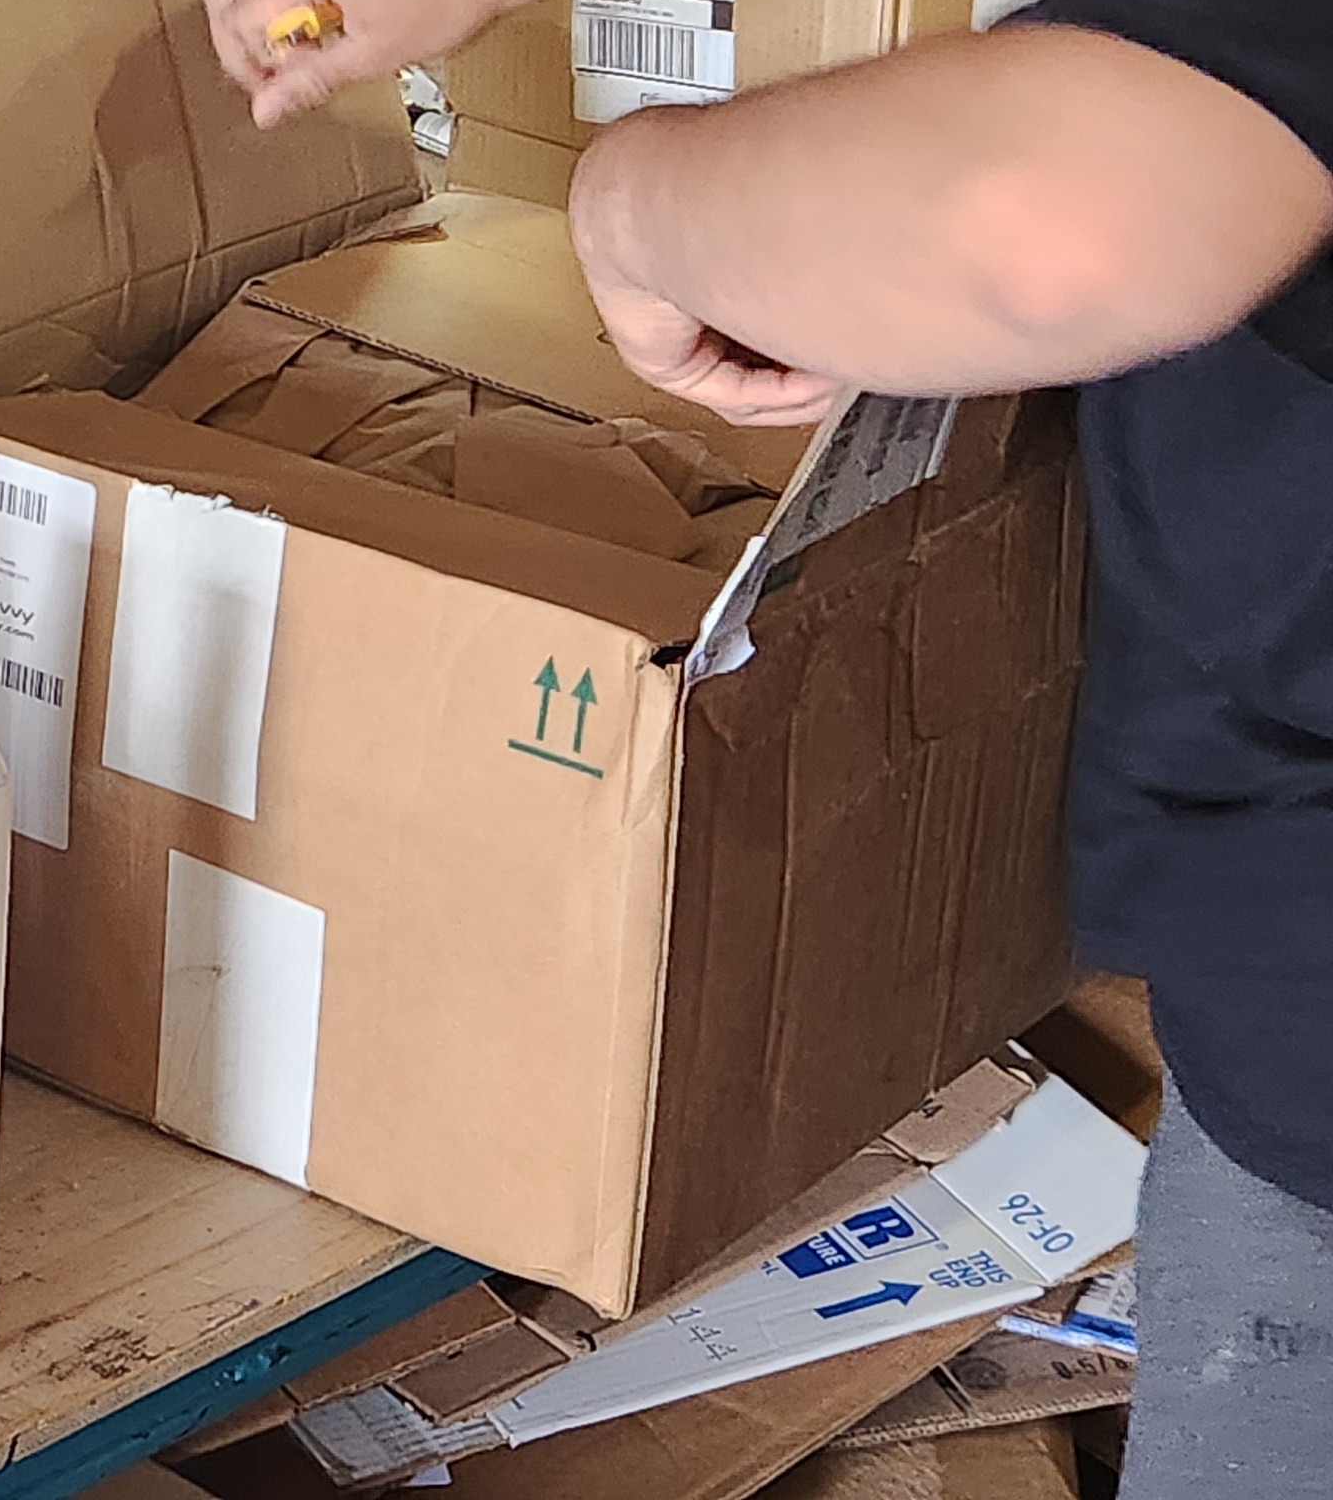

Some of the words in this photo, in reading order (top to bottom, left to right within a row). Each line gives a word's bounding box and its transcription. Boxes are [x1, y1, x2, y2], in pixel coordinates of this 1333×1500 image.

[997, 1191, 1076, 1256] OF-26
[926, 1268, 962, 1291] UP
[945, 1257, 987, 1289] END
[965, 1248, 1015, 1286] THIS
